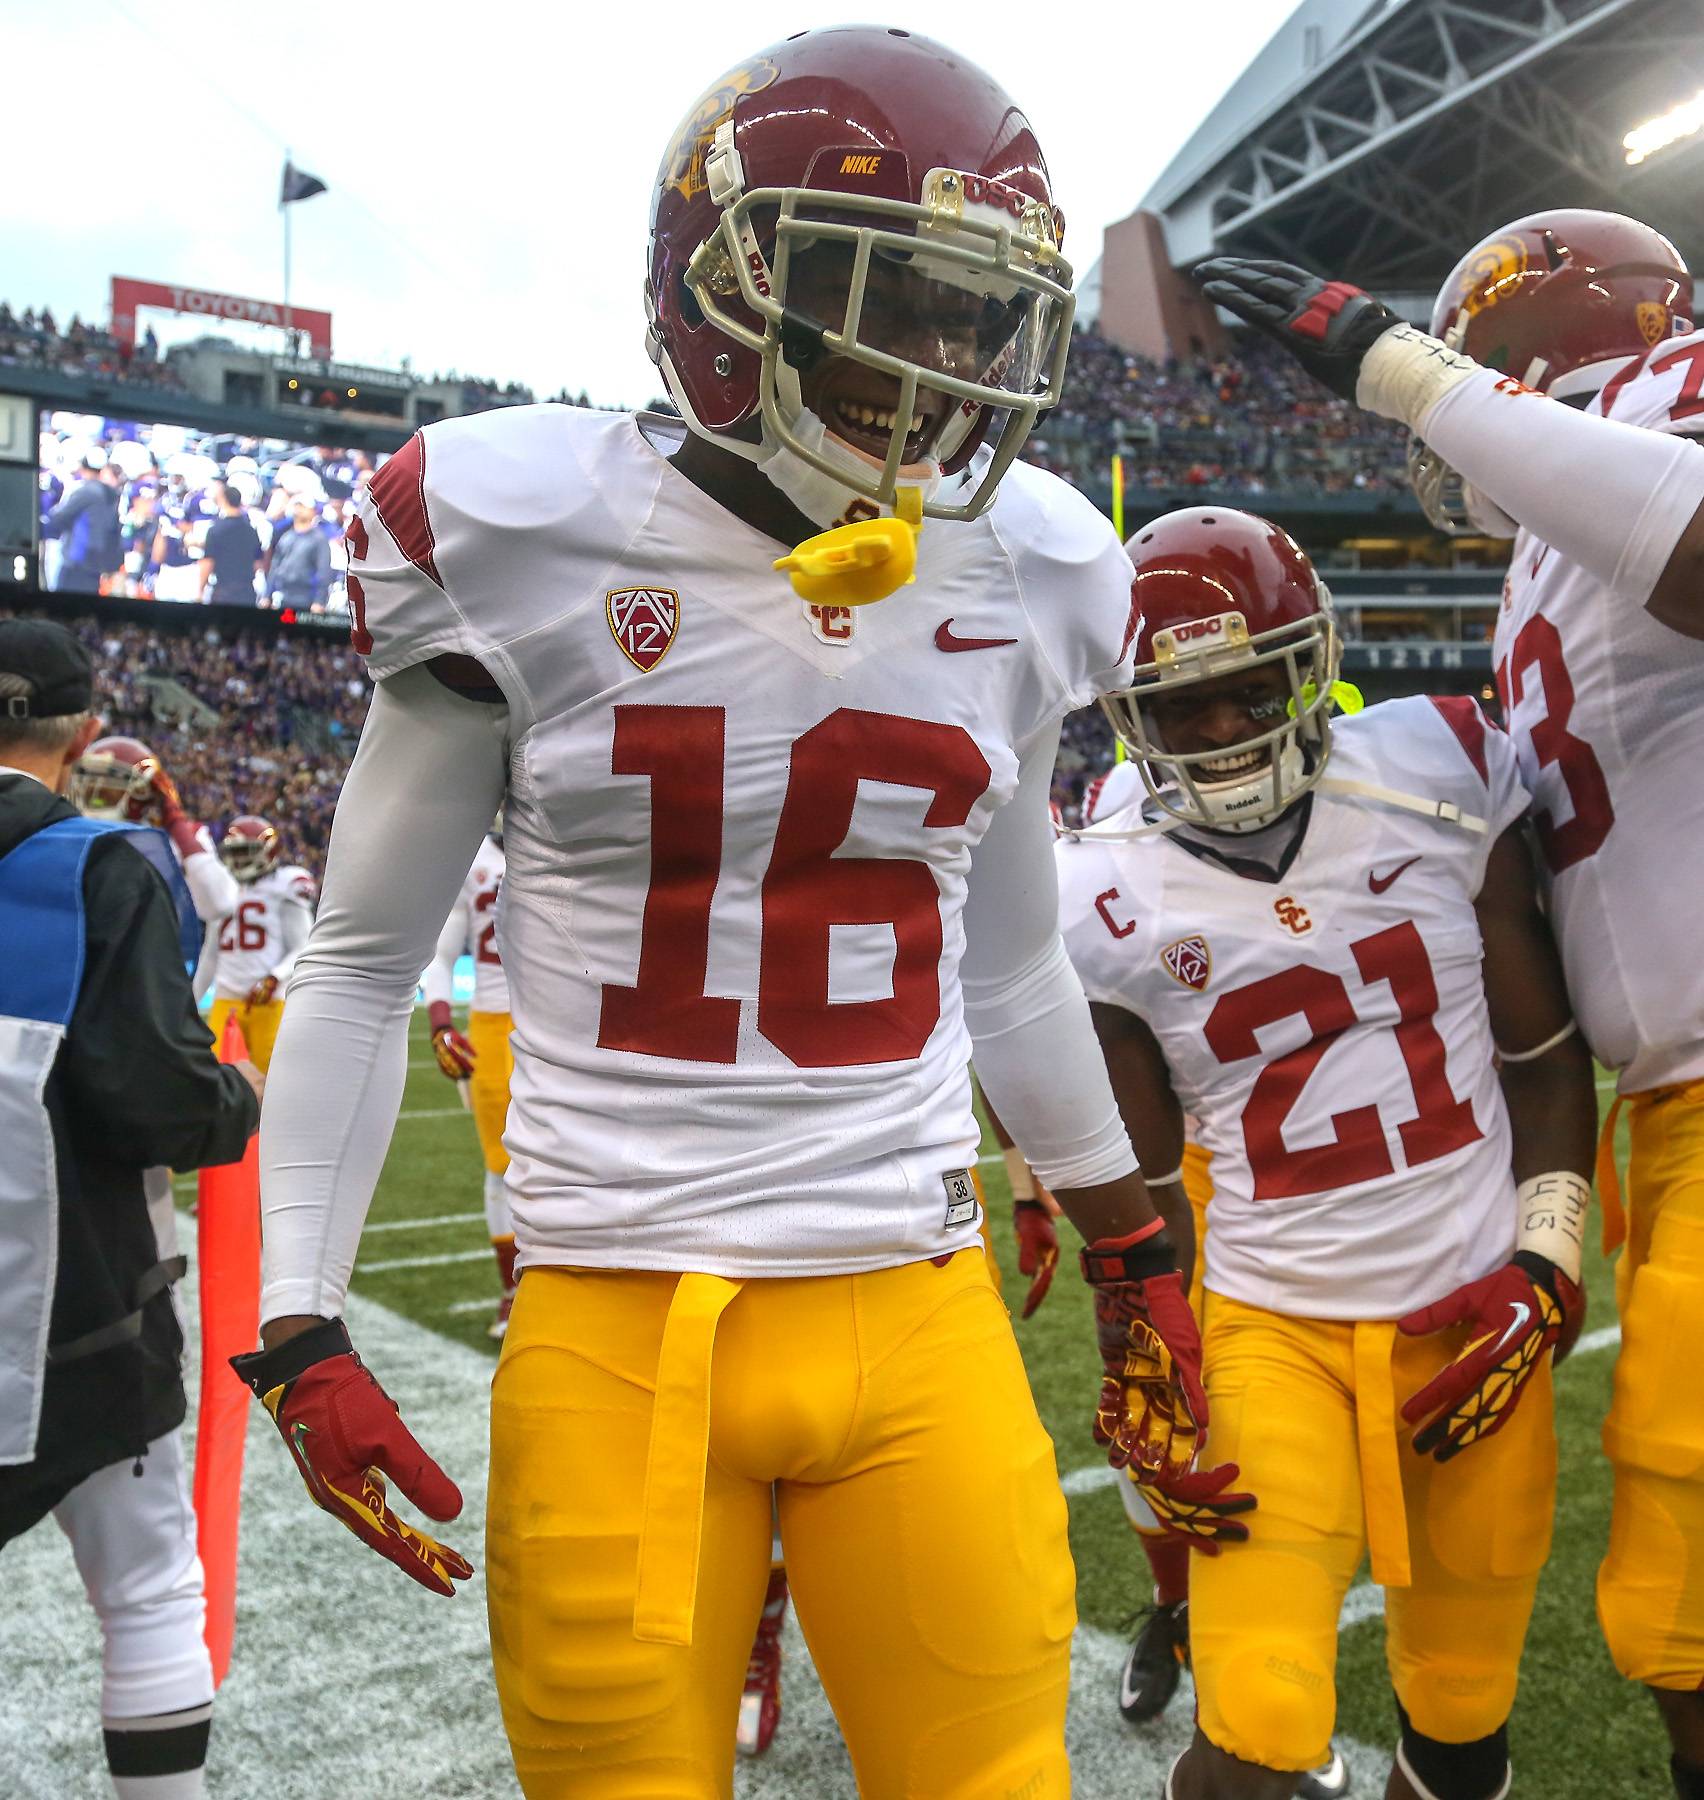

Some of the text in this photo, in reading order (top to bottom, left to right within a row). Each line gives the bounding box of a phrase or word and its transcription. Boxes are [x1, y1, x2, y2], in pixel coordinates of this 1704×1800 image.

[840, 155, 882, 175] NIKE
[963, 175, 1027, 218] USC
[171, 287, 281, 325] TOYOTA
[611, 590, 674, 638] PAC
[1172, 618, 1222, 643] USC
[627, 622, 662, 653] 12
[1367, 647, 1462, 669] 12TH
[1495, 612, 1616, 876] 3
[1225, 795, 1261, 812] Riddell
[596, 704, 992, 1068] 16
[1094, 887, 1137, 939] C
[1273, 896, 1312, 934] SC
[1181, 960, 1206, 984] 12
[1203, 919, 1485, 1200] 21
[953, 1180, 968, 1198] 38
